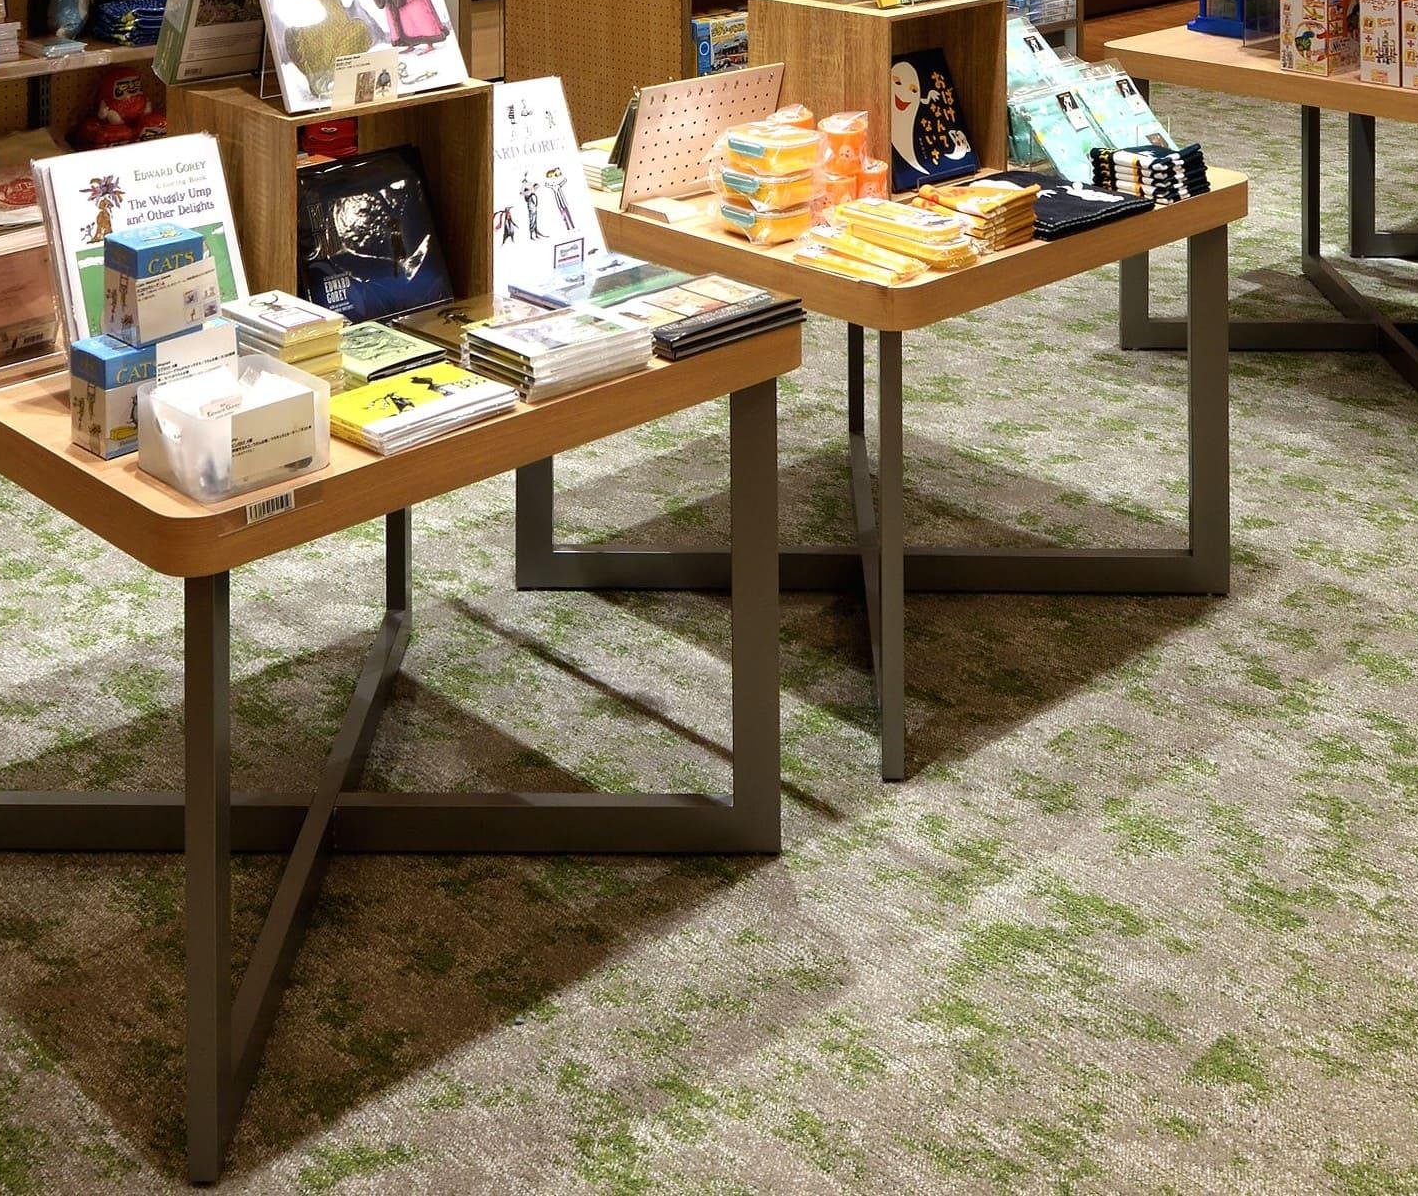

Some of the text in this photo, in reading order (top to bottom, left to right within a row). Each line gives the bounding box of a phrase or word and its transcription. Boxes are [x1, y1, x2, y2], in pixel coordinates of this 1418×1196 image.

[134, 161, 207, 181] EDWARD GOREY
[127, 187, 213, 211] The Wuggly Ump
[126, 200, 215, 226] and Other Delights
[147, 250, 196, 276] CATS
[323, 275, 351, 294] EDWARD
[325, 288, 349, 305] GOREY
[115, 362, 157, 386] CAT
